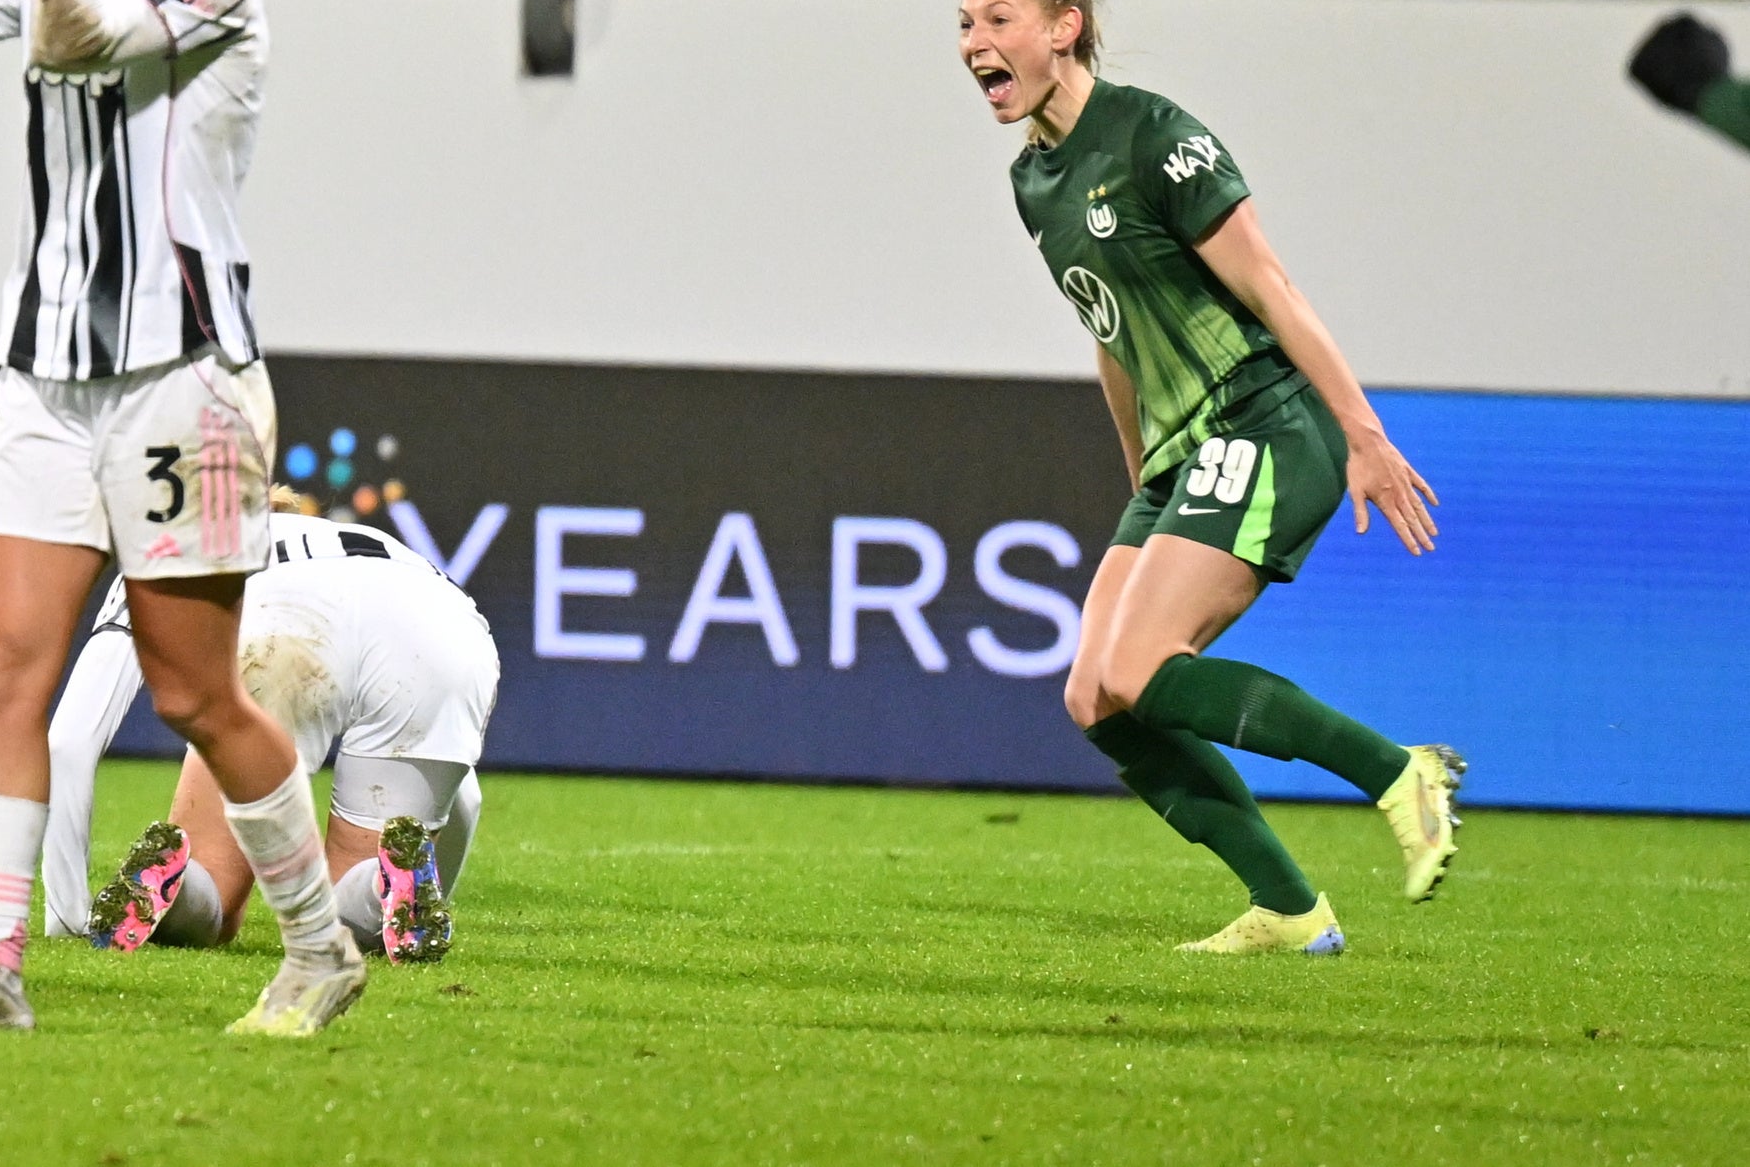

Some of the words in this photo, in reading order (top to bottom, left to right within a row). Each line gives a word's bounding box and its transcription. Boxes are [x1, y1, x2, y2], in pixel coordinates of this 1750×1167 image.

[145, 445, 185, 523] 3
[1186, 437, 1258, 504] 39
[387, 499, 1082, 678] YEARS
